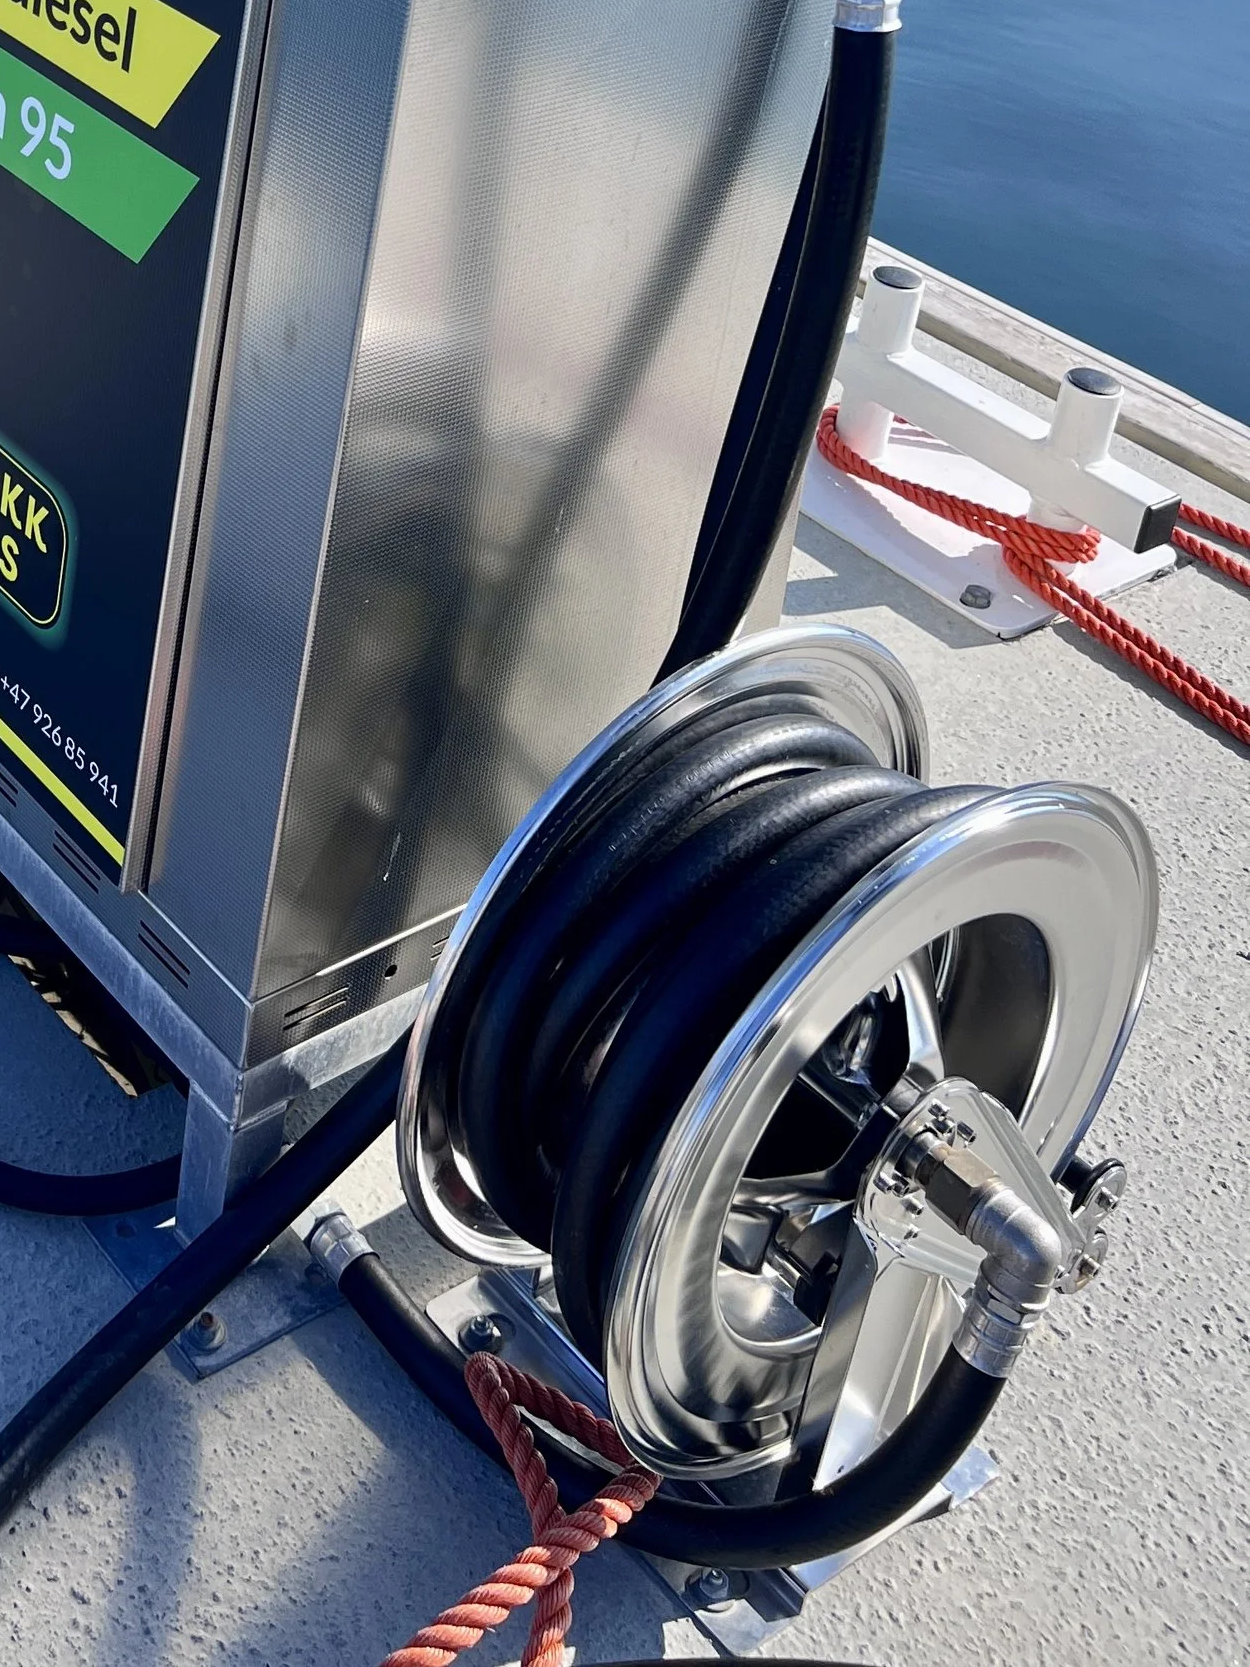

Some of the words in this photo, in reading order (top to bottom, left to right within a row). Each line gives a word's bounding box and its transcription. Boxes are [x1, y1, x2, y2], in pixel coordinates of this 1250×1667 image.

[20, 96, 75, 180] 95
[0, 675, 31, 711] +47
[33, 703, 62, 747] 926
[64, 736, 86, 771] 85
[89, 760, 119, 808] 941
